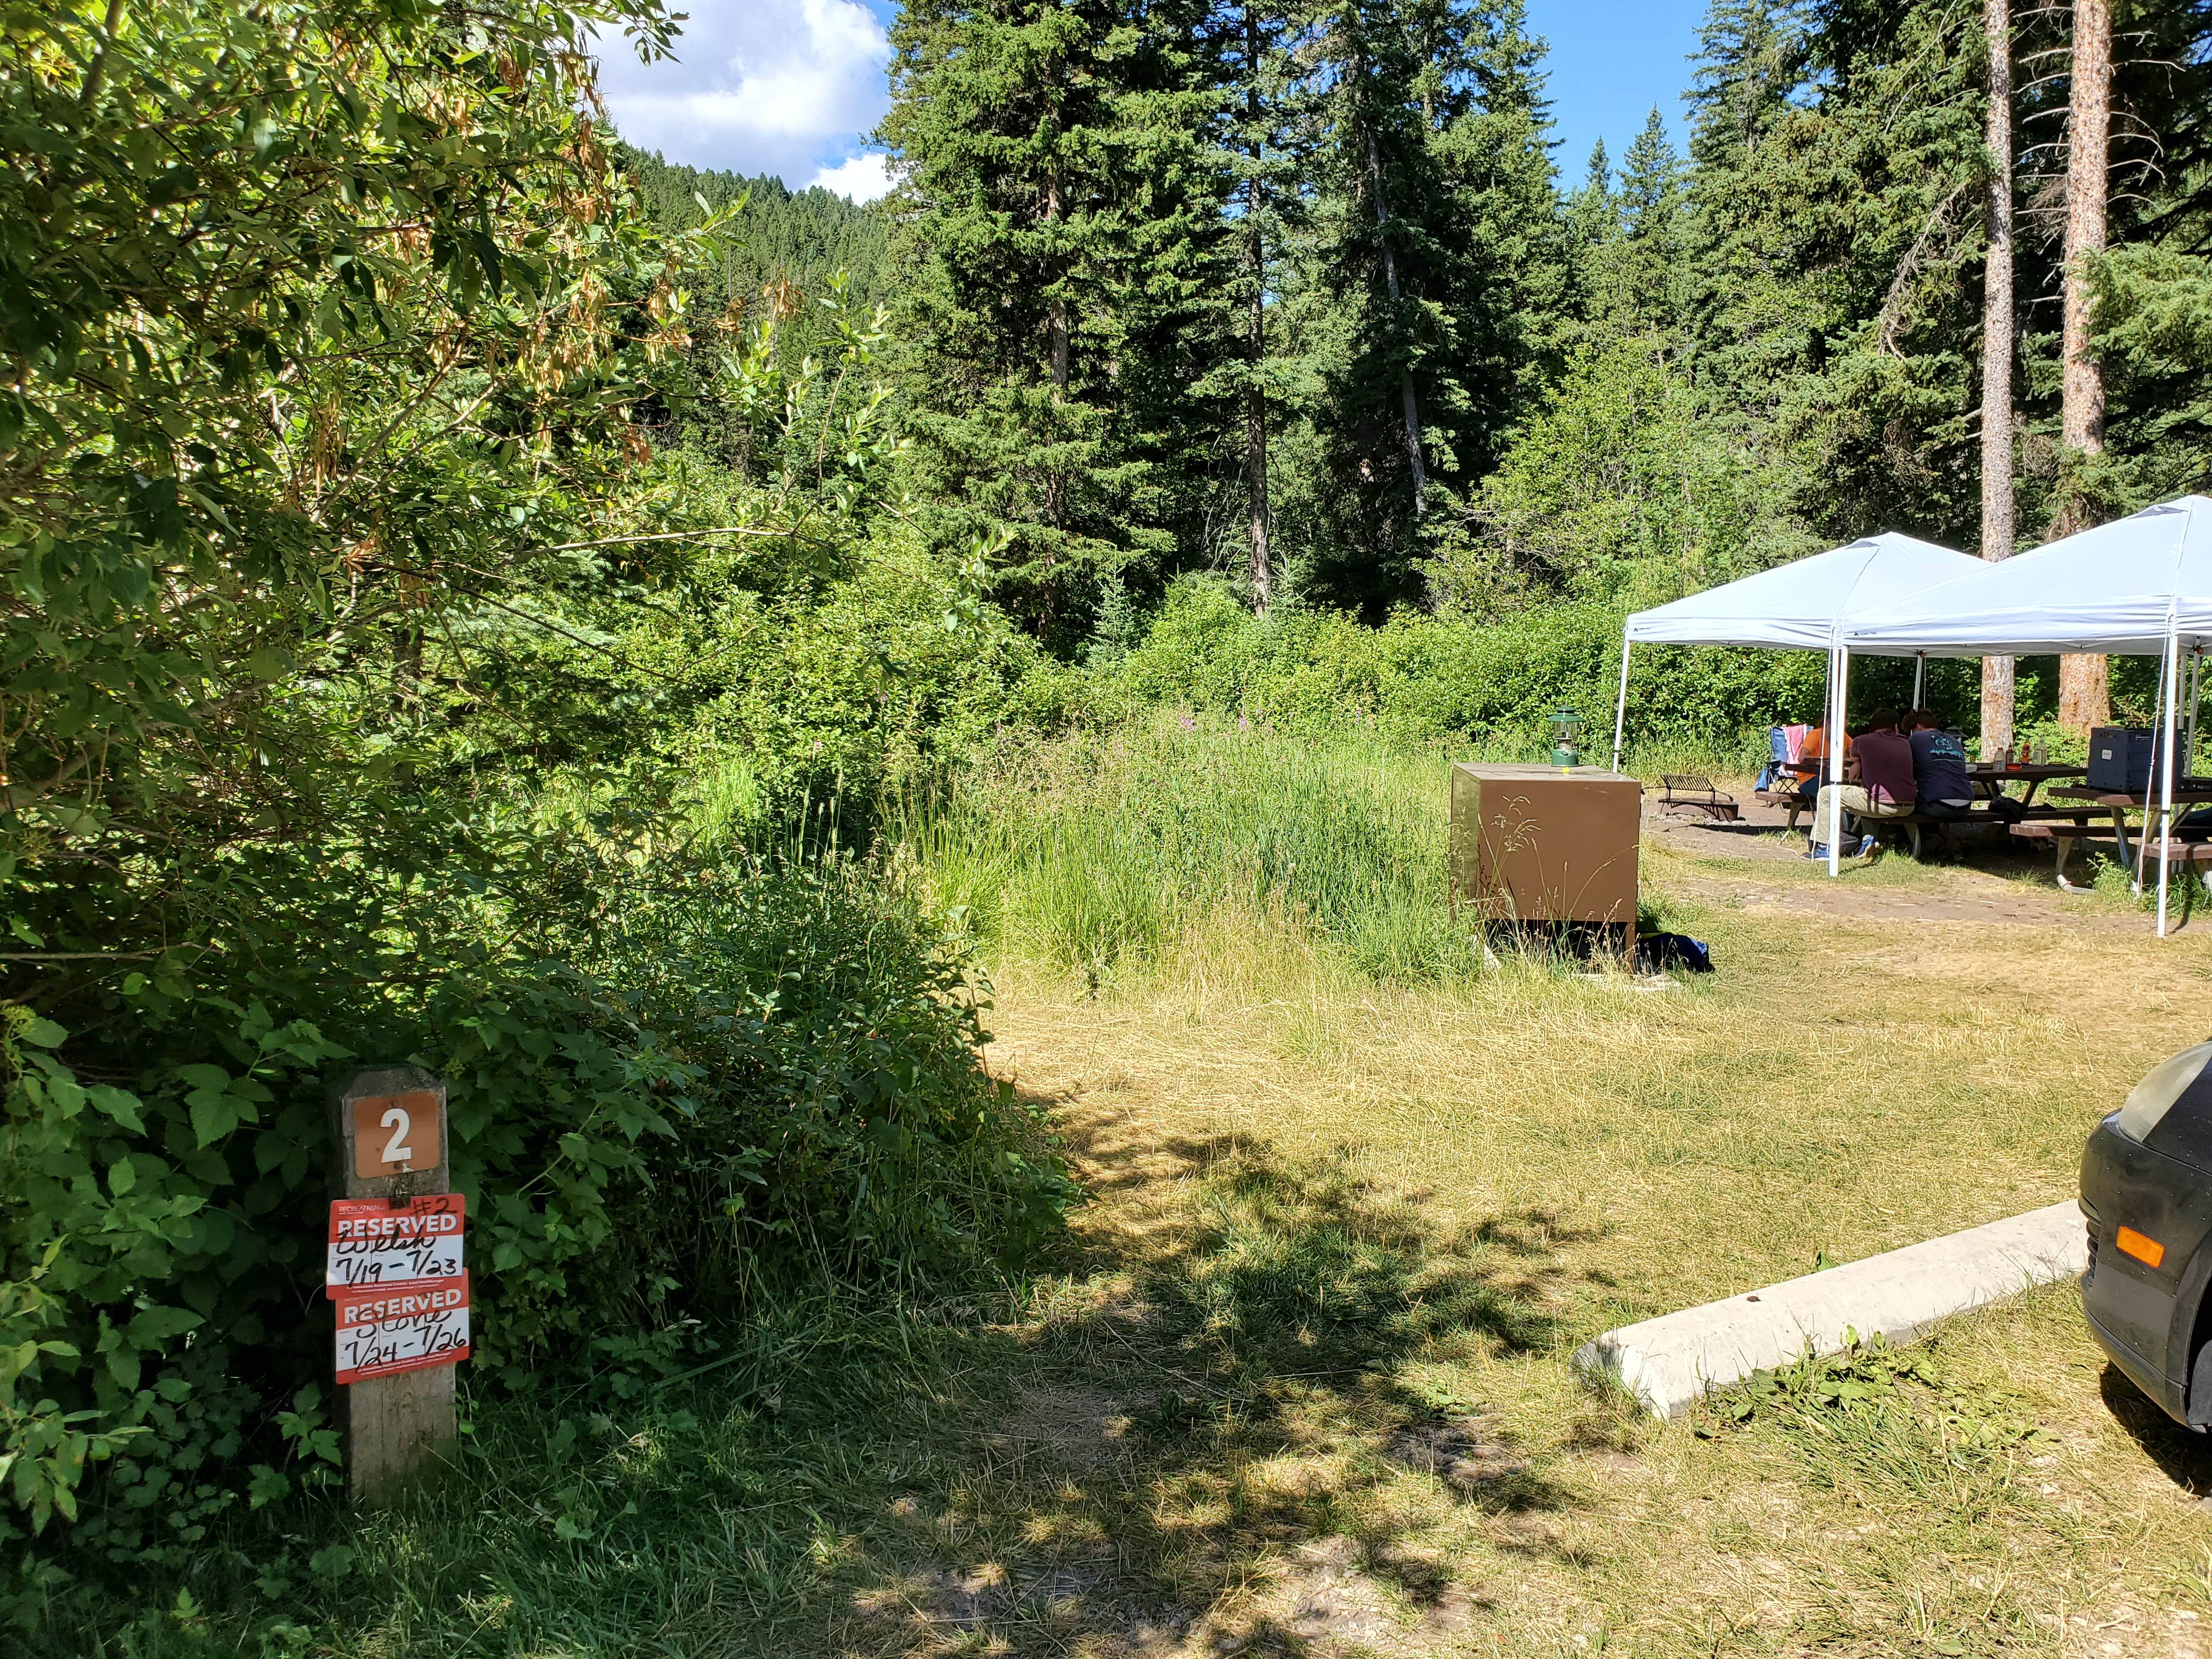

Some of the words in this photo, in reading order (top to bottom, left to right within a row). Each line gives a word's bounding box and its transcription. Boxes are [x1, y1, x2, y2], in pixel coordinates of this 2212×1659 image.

[380, 1108, 411, 1163] 2
[410, 1197, 457, 1216] #2
[337, 1214, 456, 1238] RESERVED
[336, 1257, 383, 1288] 7/19
[406, 1250, 456, 1276] 7/23
[344, 1289, 461, 1324] RESERVED
[357, 1306, 452, 1338] Stone
[345, 1336, 397, 1373] 7/24
[413, 1323, 466, 1355] 7/26
